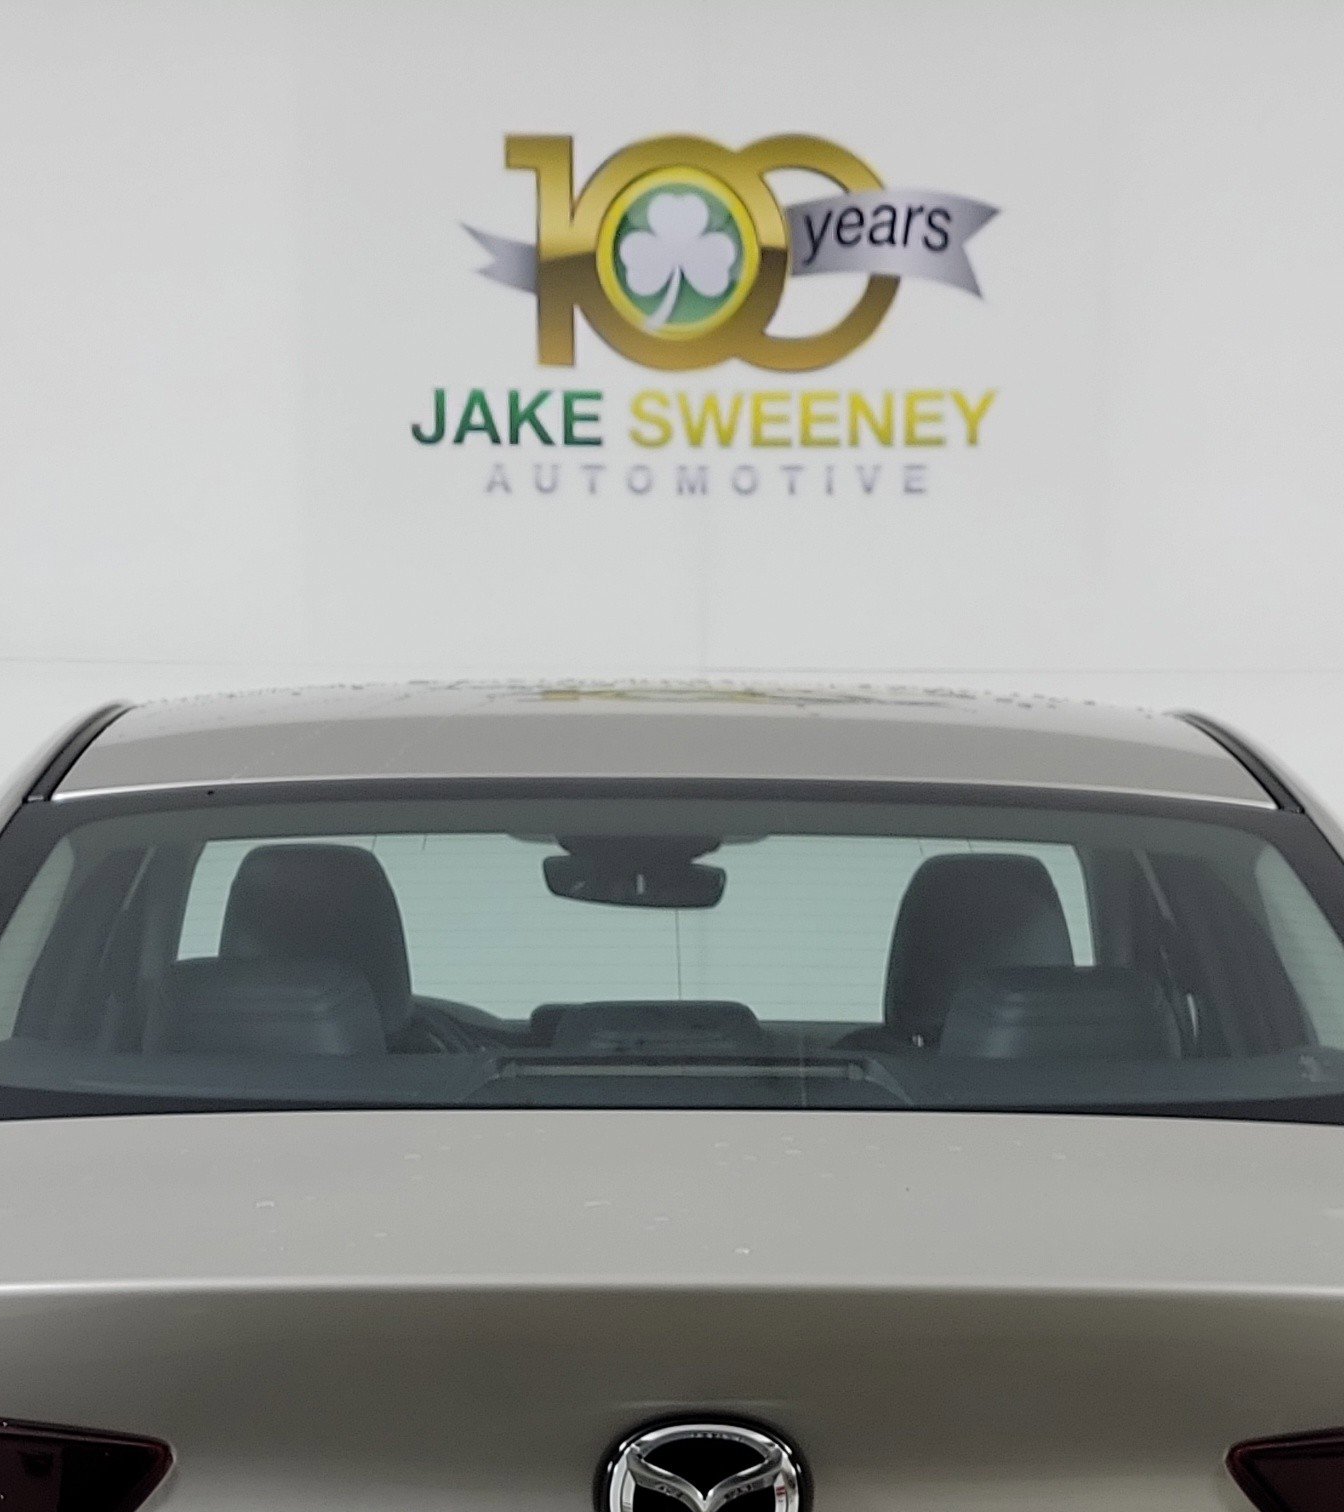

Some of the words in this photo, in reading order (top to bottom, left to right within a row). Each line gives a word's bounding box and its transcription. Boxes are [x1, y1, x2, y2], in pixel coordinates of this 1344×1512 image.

[504, 133, 902, 374] 100
[801, 200, 952, 265] years
[411, 388, 604, 447] JAKE
[628, 388, 998, 448] SWEENEY
[484, 463, 929, 496] AUTOMOTIVE
